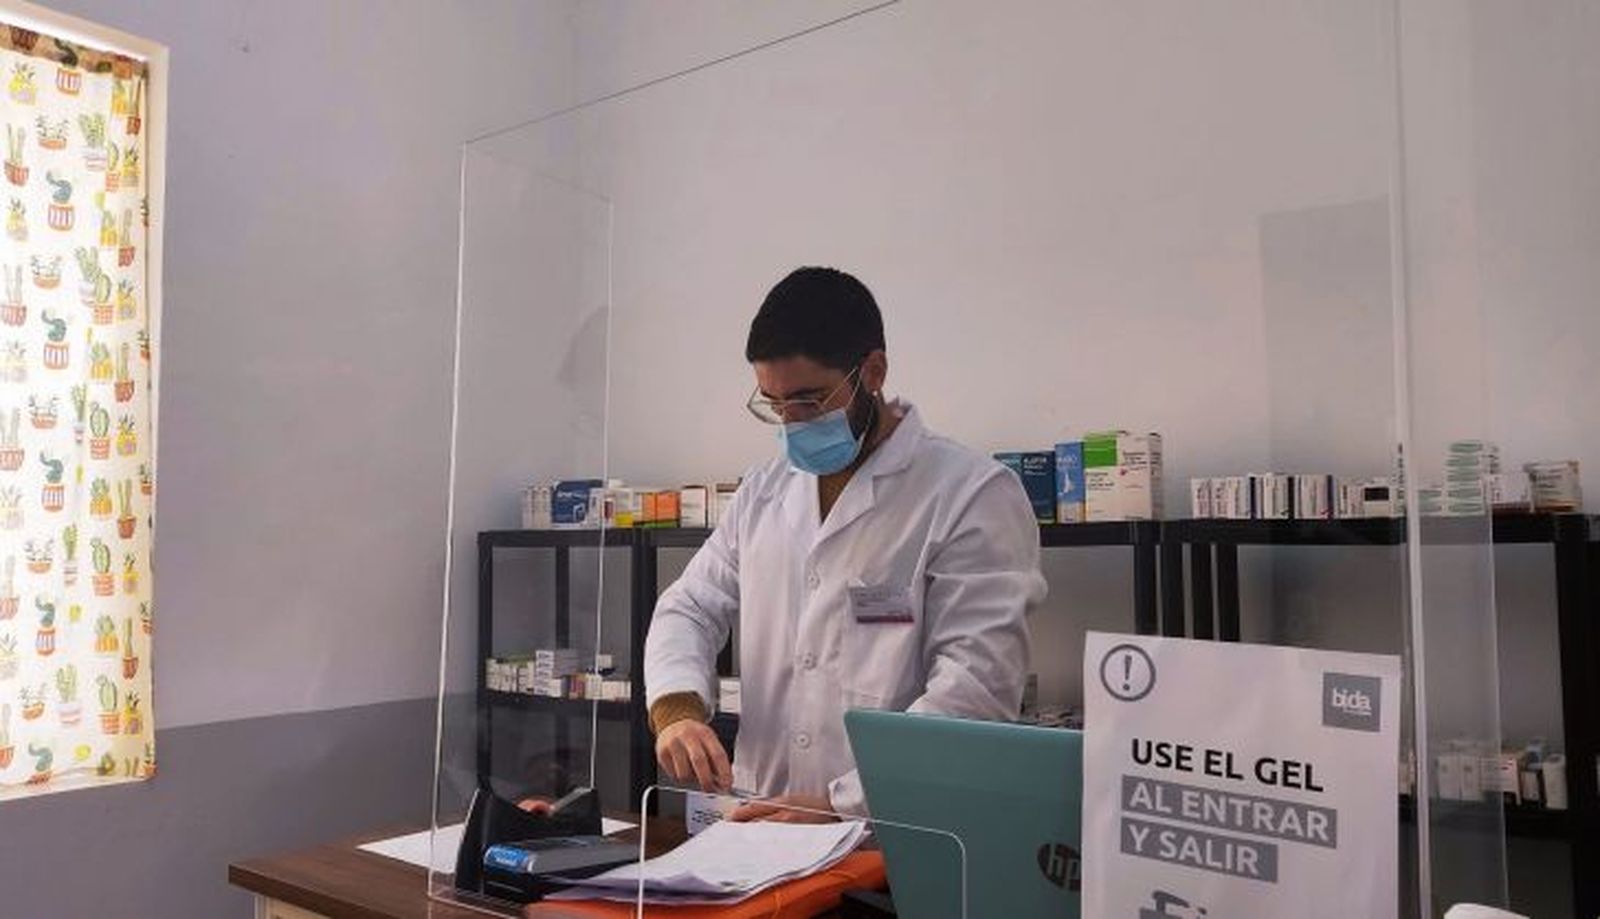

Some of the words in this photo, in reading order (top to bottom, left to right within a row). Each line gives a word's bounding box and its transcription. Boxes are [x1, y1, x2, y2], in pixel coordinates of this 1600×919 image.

[1332, 687, 1372, 711] bida
[1132, 739, 1193, 772] USE
[1204, 749, 1244, 780] EL
[1254, 757, 1324, 792] GEL
[1129, 782, 1172, 813] AL
[1181, 791, 1330, 841] ENTRAR
[1128, 826, 1149, 851] Y
[1159, 834, 1260, 874] SALIR
